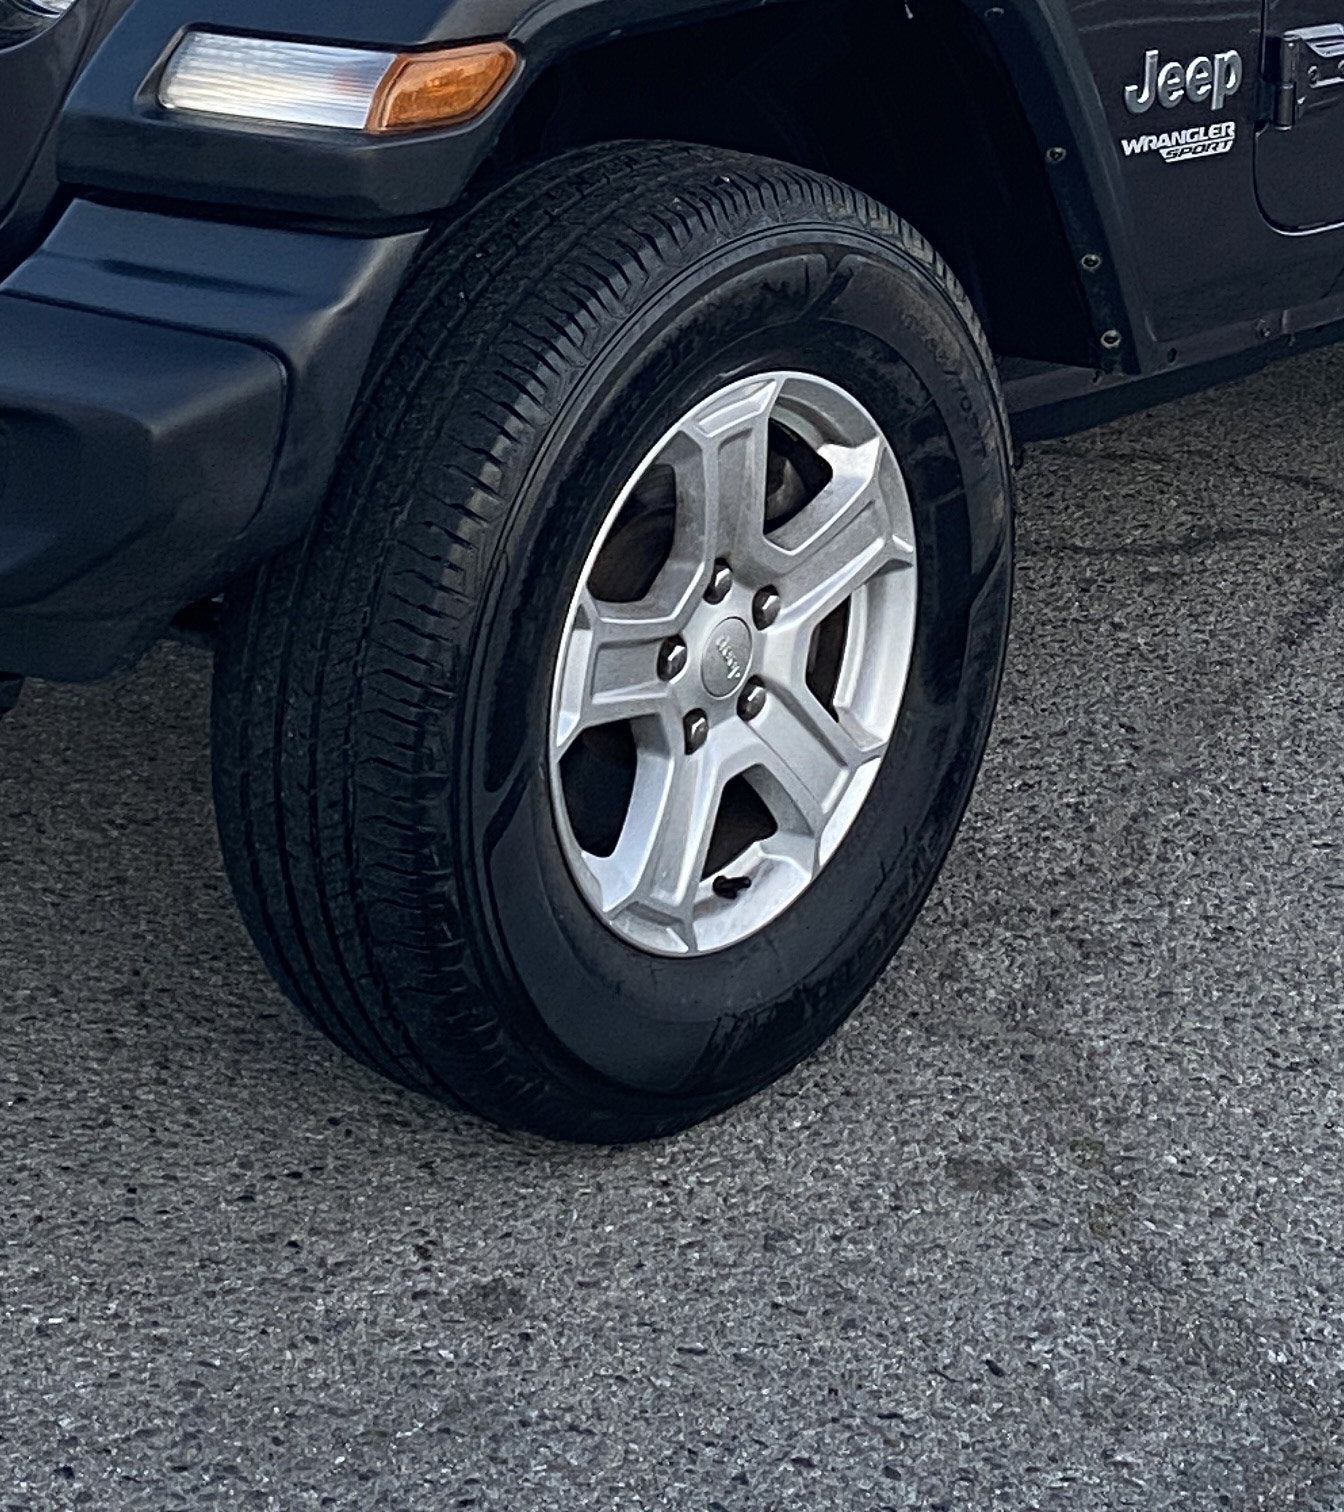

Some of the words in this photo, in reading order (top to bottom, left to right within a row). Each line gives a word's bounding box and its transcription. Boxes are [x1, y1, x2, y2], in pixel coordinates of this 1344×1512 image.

[1124, 49, 1243, 114] Jeep
[1121, 121, 1236, 157] WRANGLER
[1163, 139, 1234, 160] SPORT
